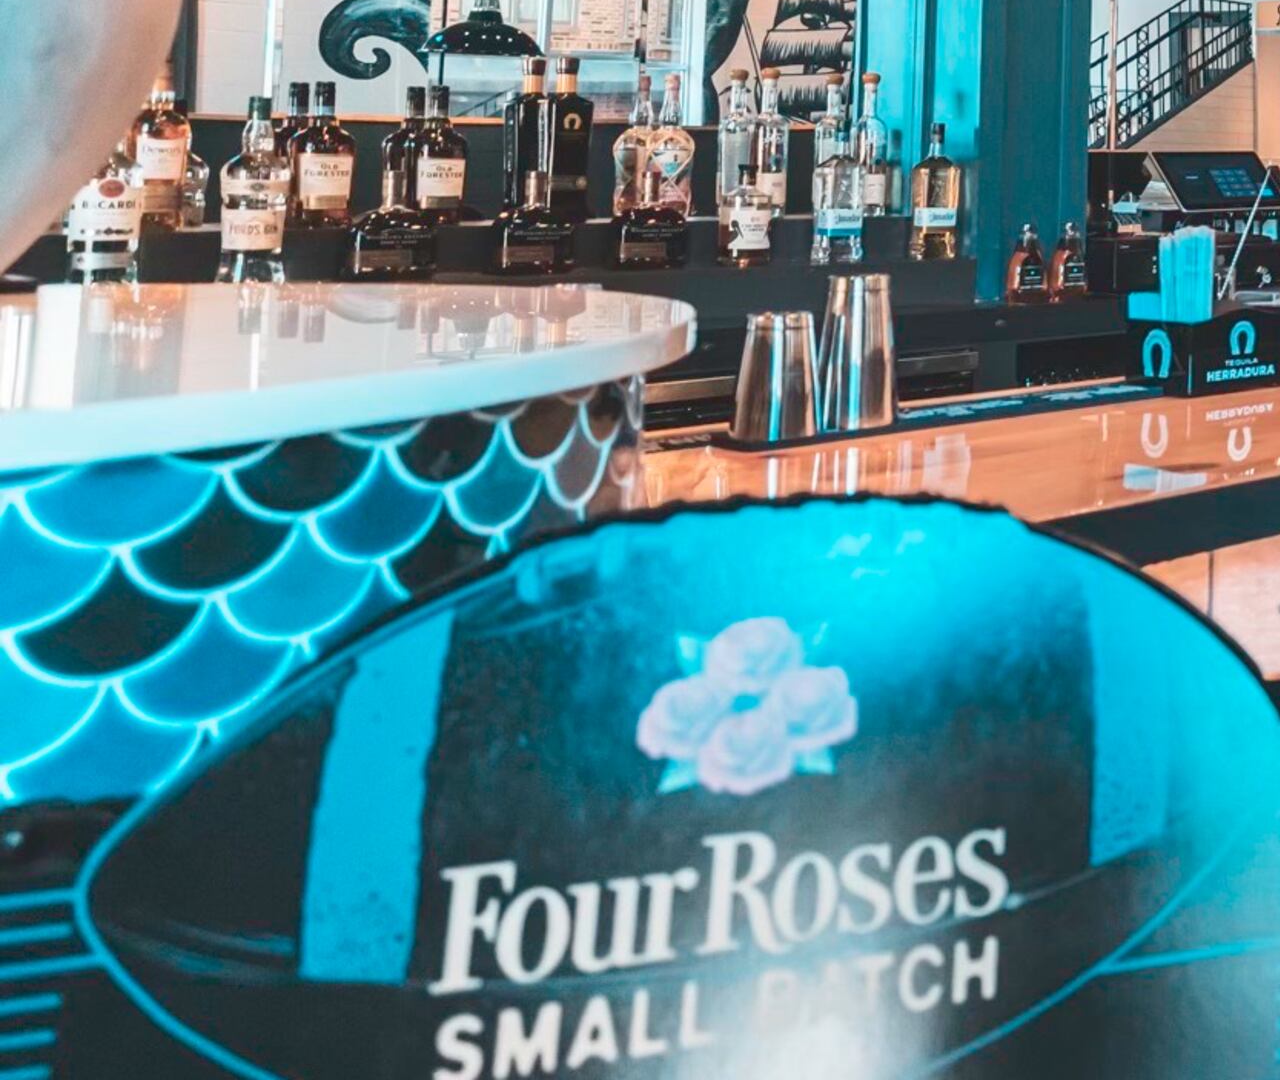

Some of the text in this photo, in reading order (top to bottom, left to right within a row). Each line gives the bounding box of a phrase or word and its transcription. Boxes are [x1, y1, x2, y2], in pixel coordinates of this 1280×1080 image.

[82, 200, 137, 210] BCARDI
[1225, 357, 1258, 366] TEQUILA
[1206, 364, 1275, 383] HERRADURA
[427, 828, 1009, 996] Four Roses
[431, 979, 713, 1080] SMALL
